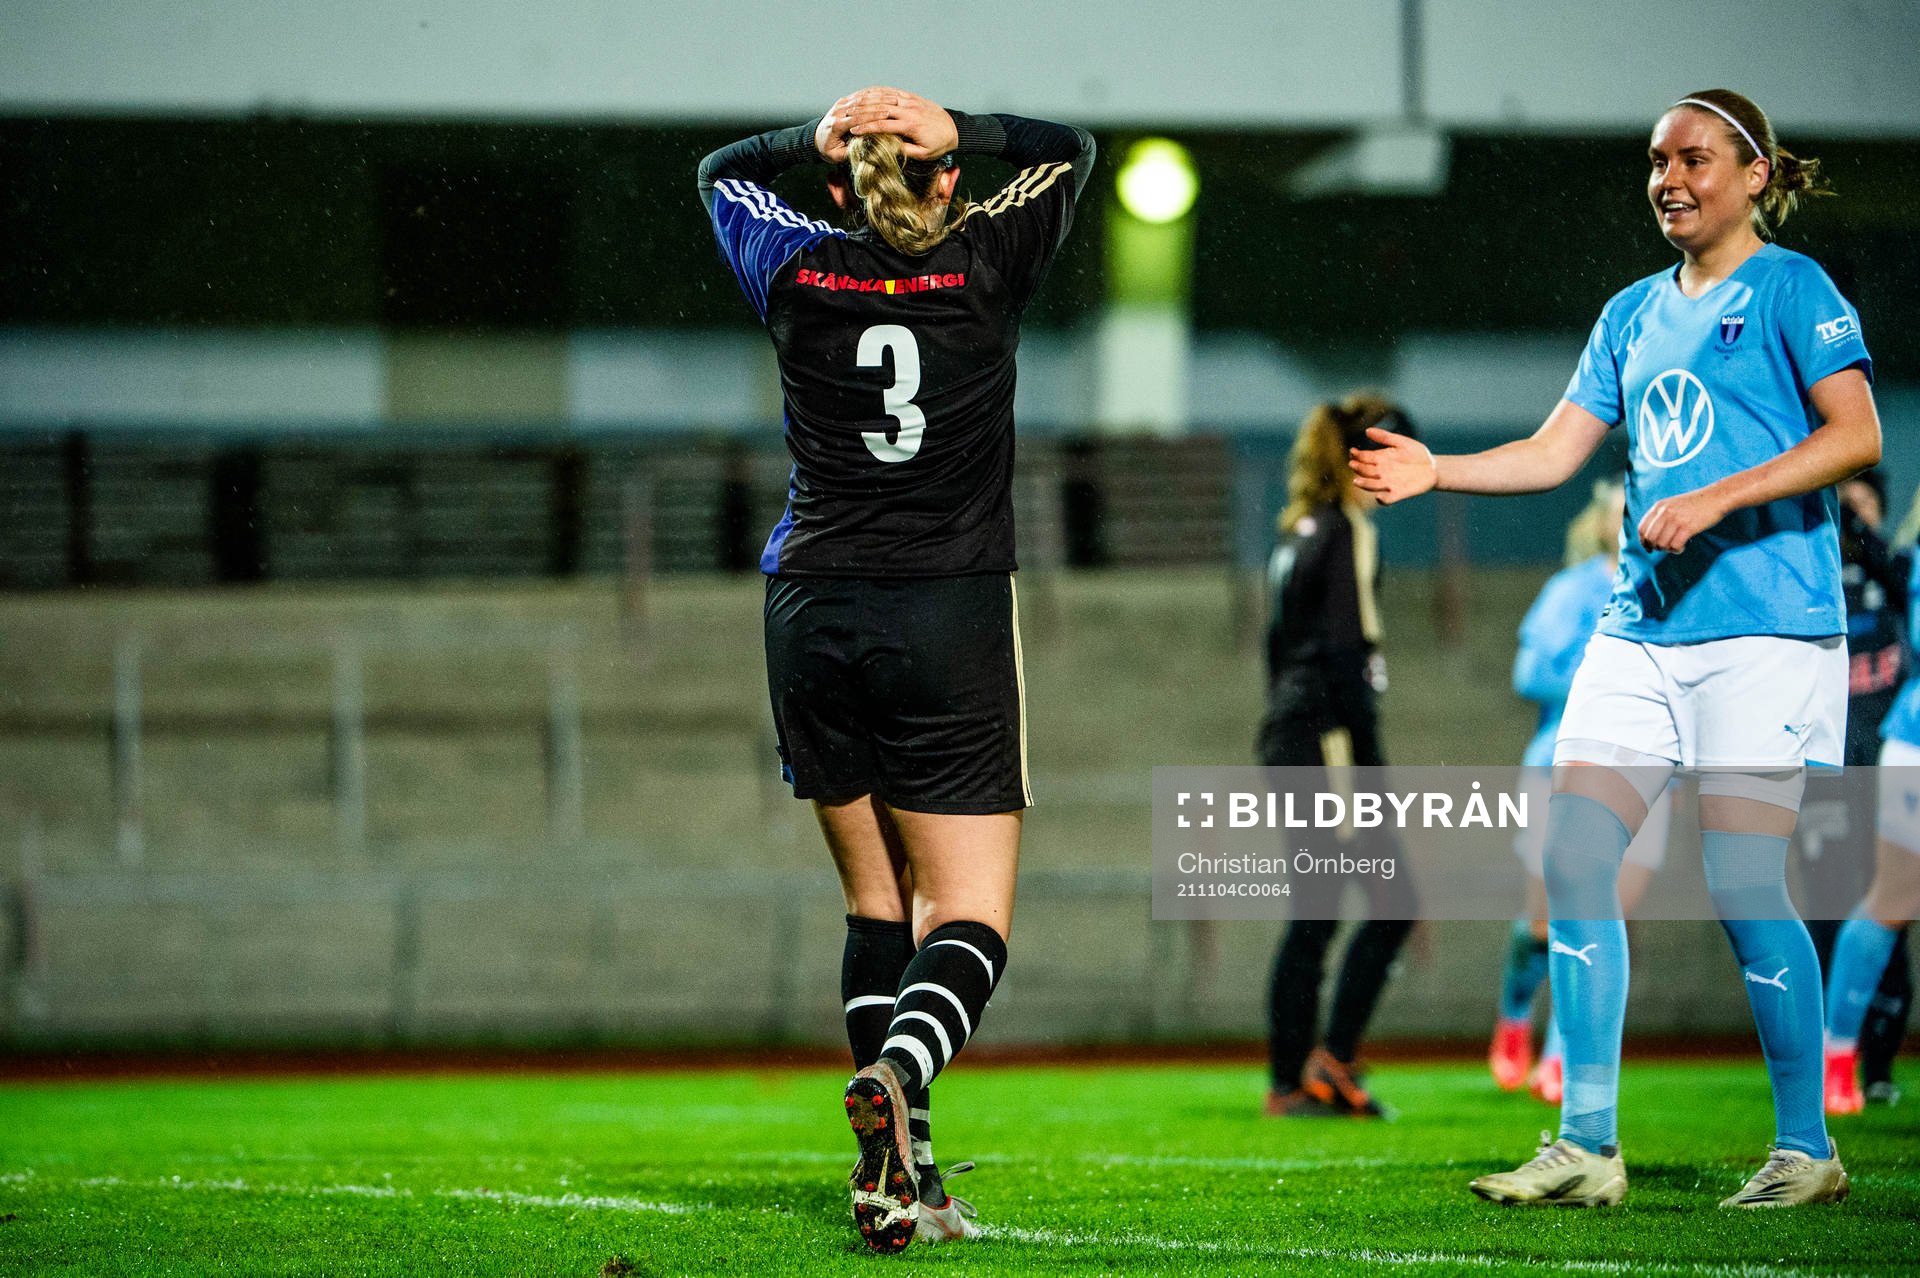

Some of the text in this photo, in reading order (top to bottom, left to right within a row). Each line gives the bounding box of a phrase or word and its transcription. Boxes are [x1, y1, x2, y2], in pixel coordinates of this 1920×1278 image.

[796, 269, 965, 294] SKÅNSKA ENERGI
[856, 324, 927, 463] 3
